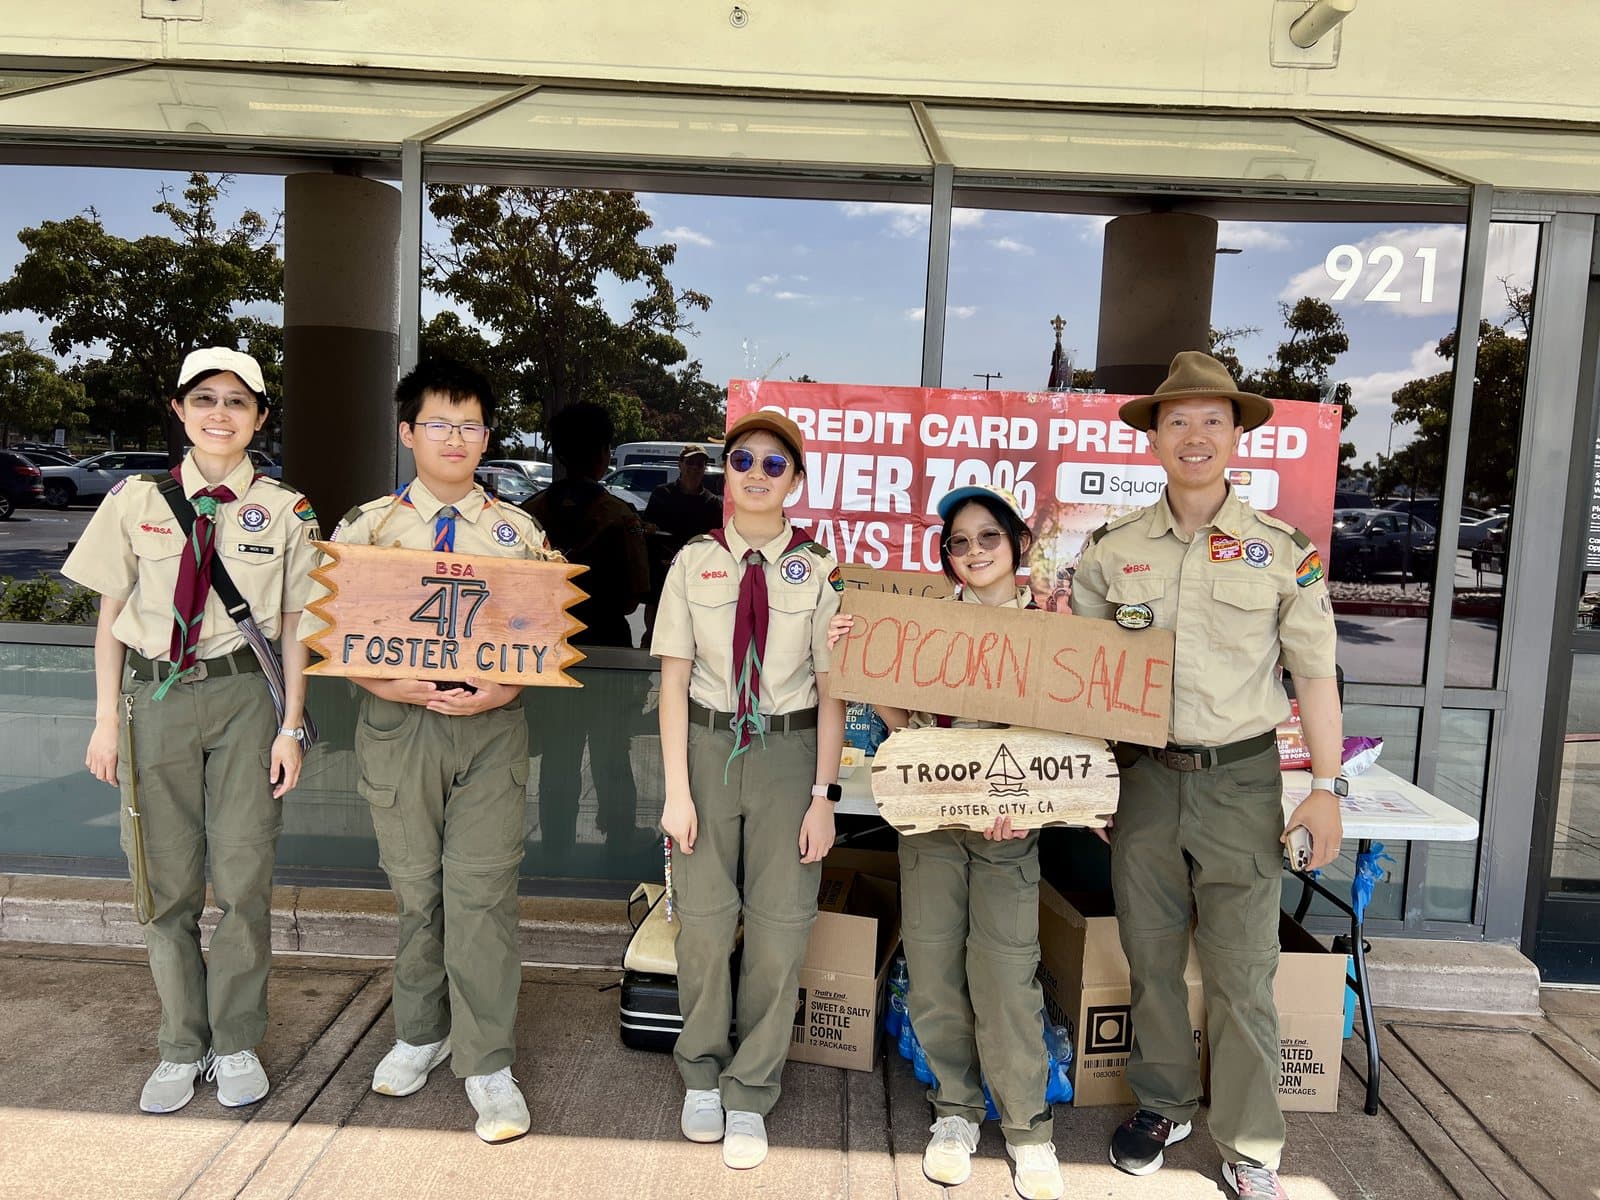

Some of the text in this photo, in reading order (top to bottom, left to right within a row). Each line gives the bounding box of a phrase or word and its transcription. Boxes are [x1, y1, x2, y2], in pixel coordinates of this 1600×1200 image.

[1325, 244, 1437, 303] 921
[758, 405, 912, 445] REDIT
[919, 413, 1038, 450] CARD
[784, 451, 913, 514] VER
[1109, 476, 1166, 497] Squar
[153, 527, 173, 535] BSA
[435, 561, 475, 578] BSA
[711, 570, 728, 579] BSA
[1133, 564, 1151, 573] BSA
[342, 633, 549, 674] FOSTER CITY
[839, 614, 1170, 719] POPCORN SALE
[895, 754, 1092, 784] TROOP 4047
[940, 804, 990, 817] FOSTER
[1037, 801, 1054, 813] CA
[811, 1000, 871, 1018] SWEET & SALTY
[810, 1011, 851, 1029] KETTLE
[809, 1025, 843, 1041] CORN
[819, 1040, 857, 1052] PACKAGES
[1280, 1048, 1313, 1061] ALTED
[1280, 1061, 1326, 1075] ARAMEL
[1278, 1075, 1302, 1087] ORN
[1278, 1087, 1317, 1096] PACKAGES
